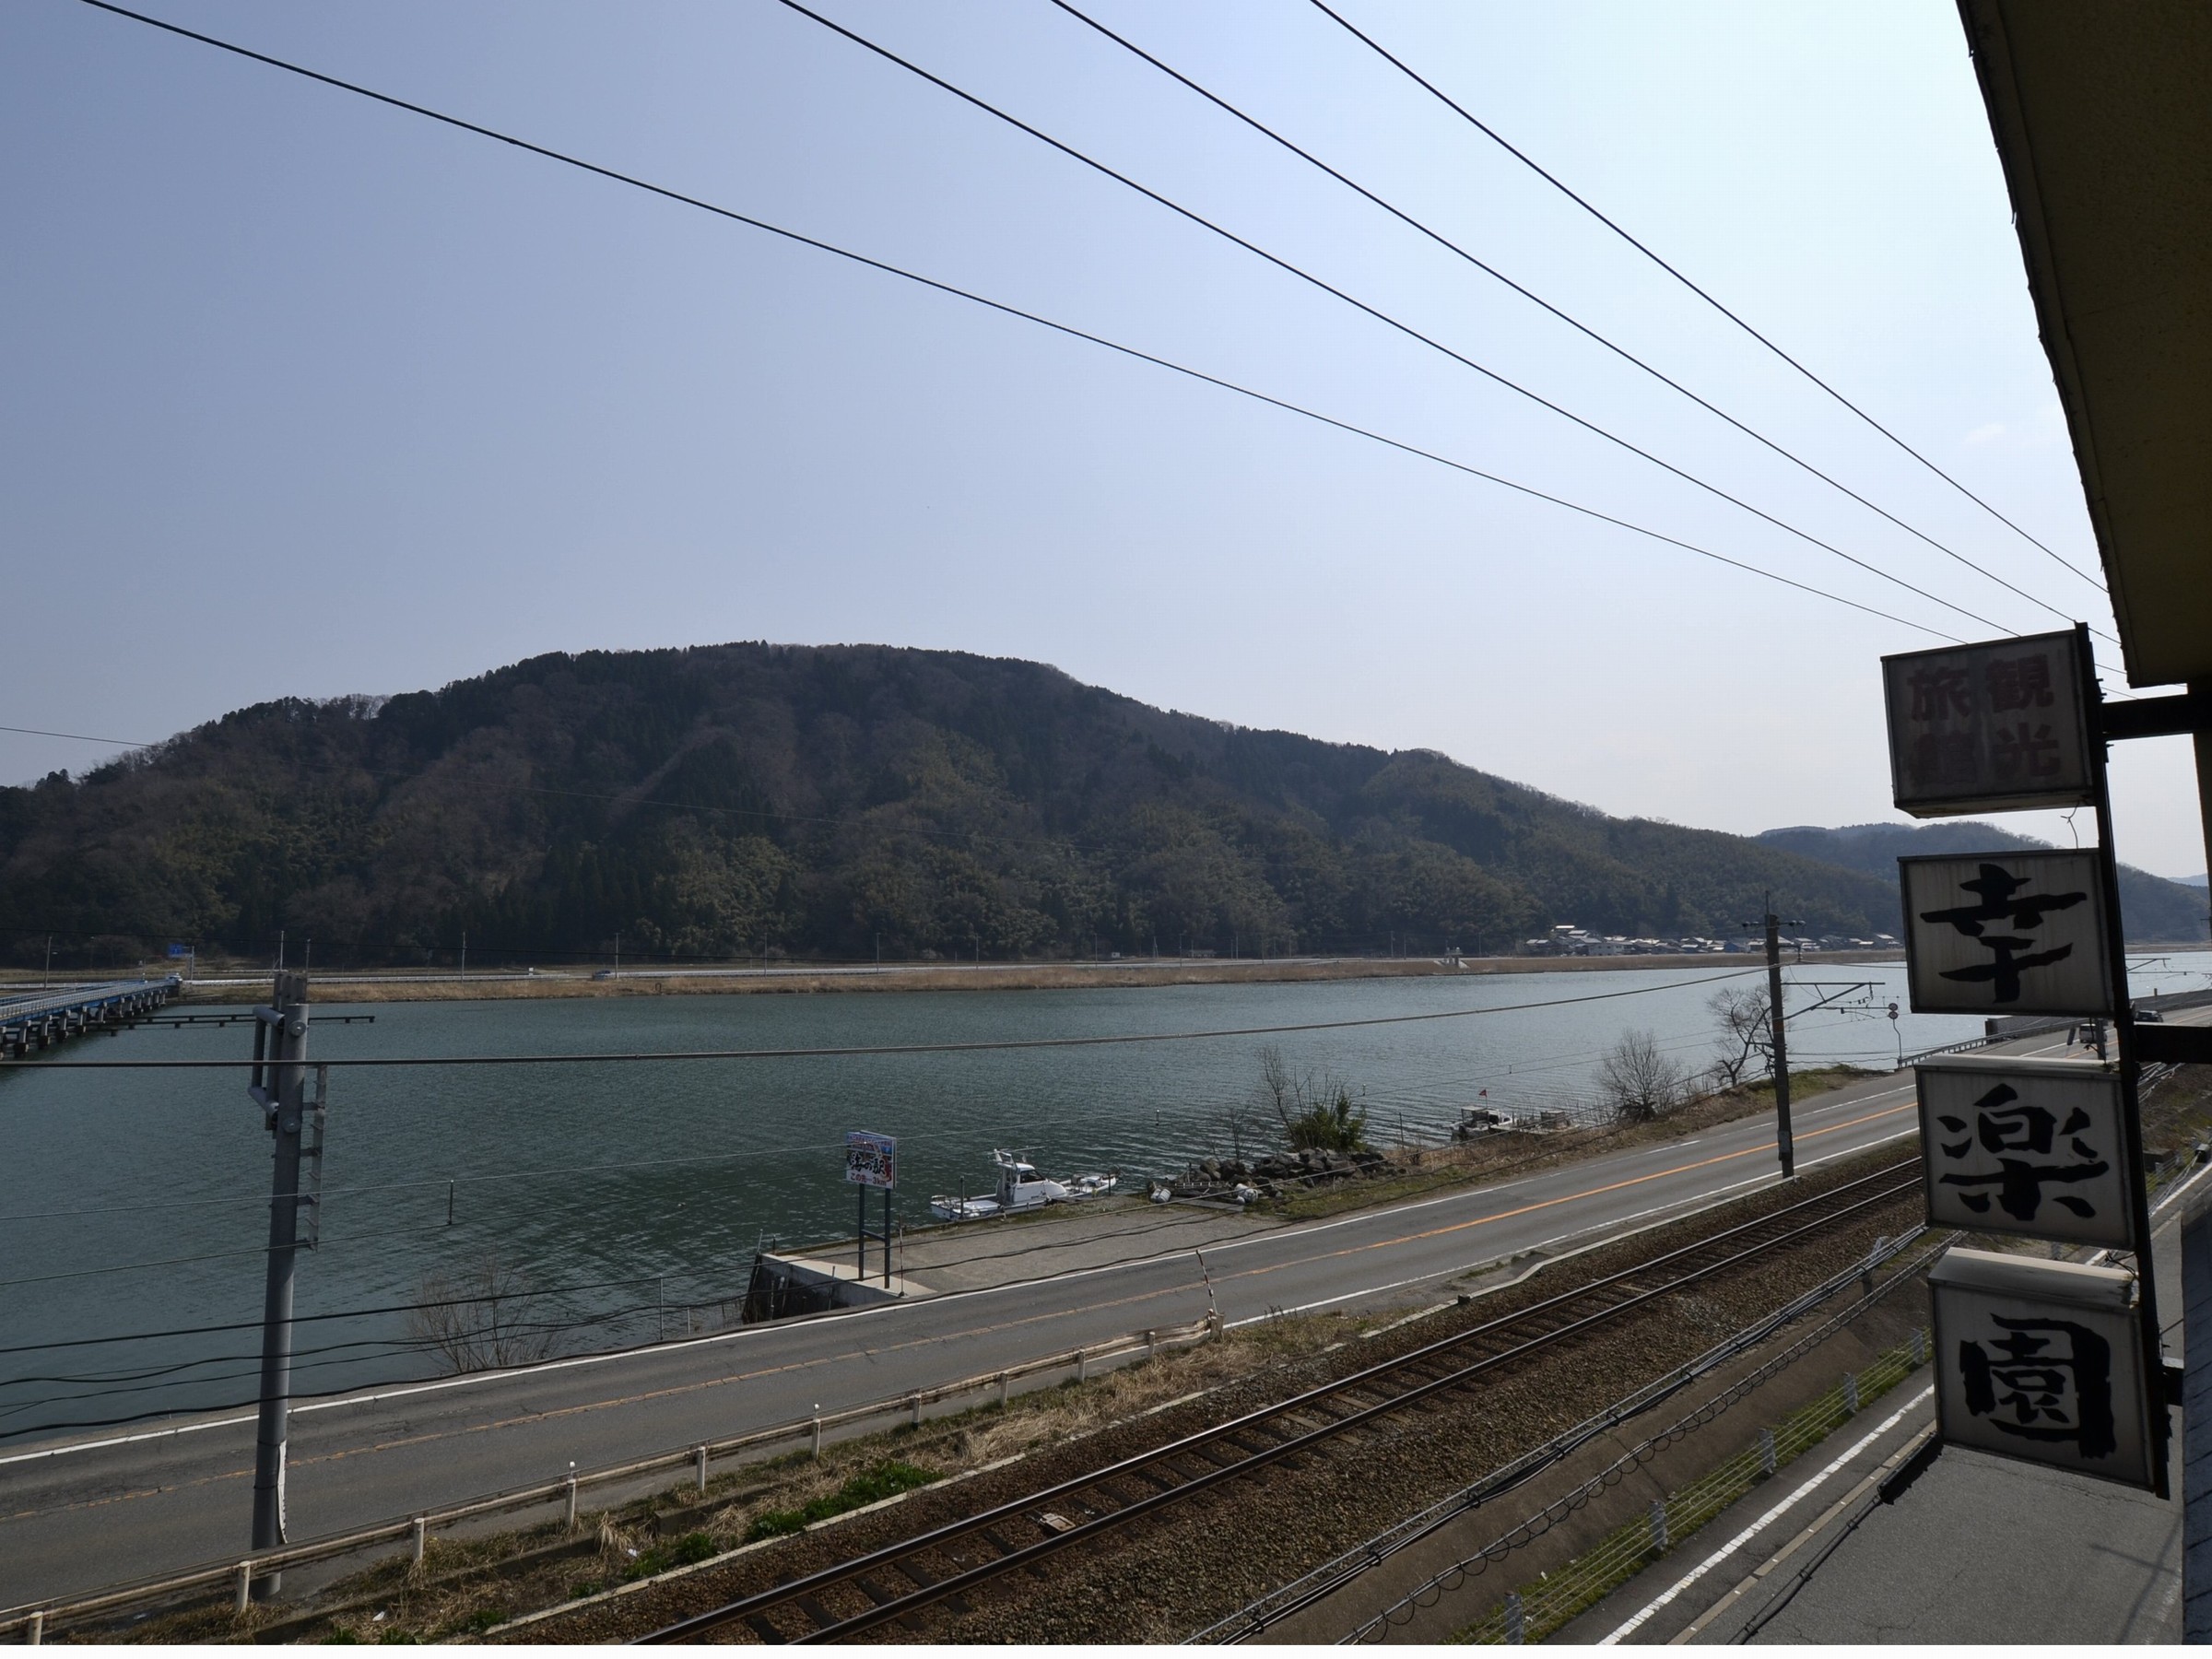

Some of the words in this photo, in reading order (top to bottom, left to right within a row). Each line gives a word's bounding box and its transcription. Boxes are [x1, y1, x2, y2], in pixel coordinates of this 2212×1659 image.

[1986, 653, 2061, 779] 観光
[1920, 864, 2117, 1460] 幸楽園
